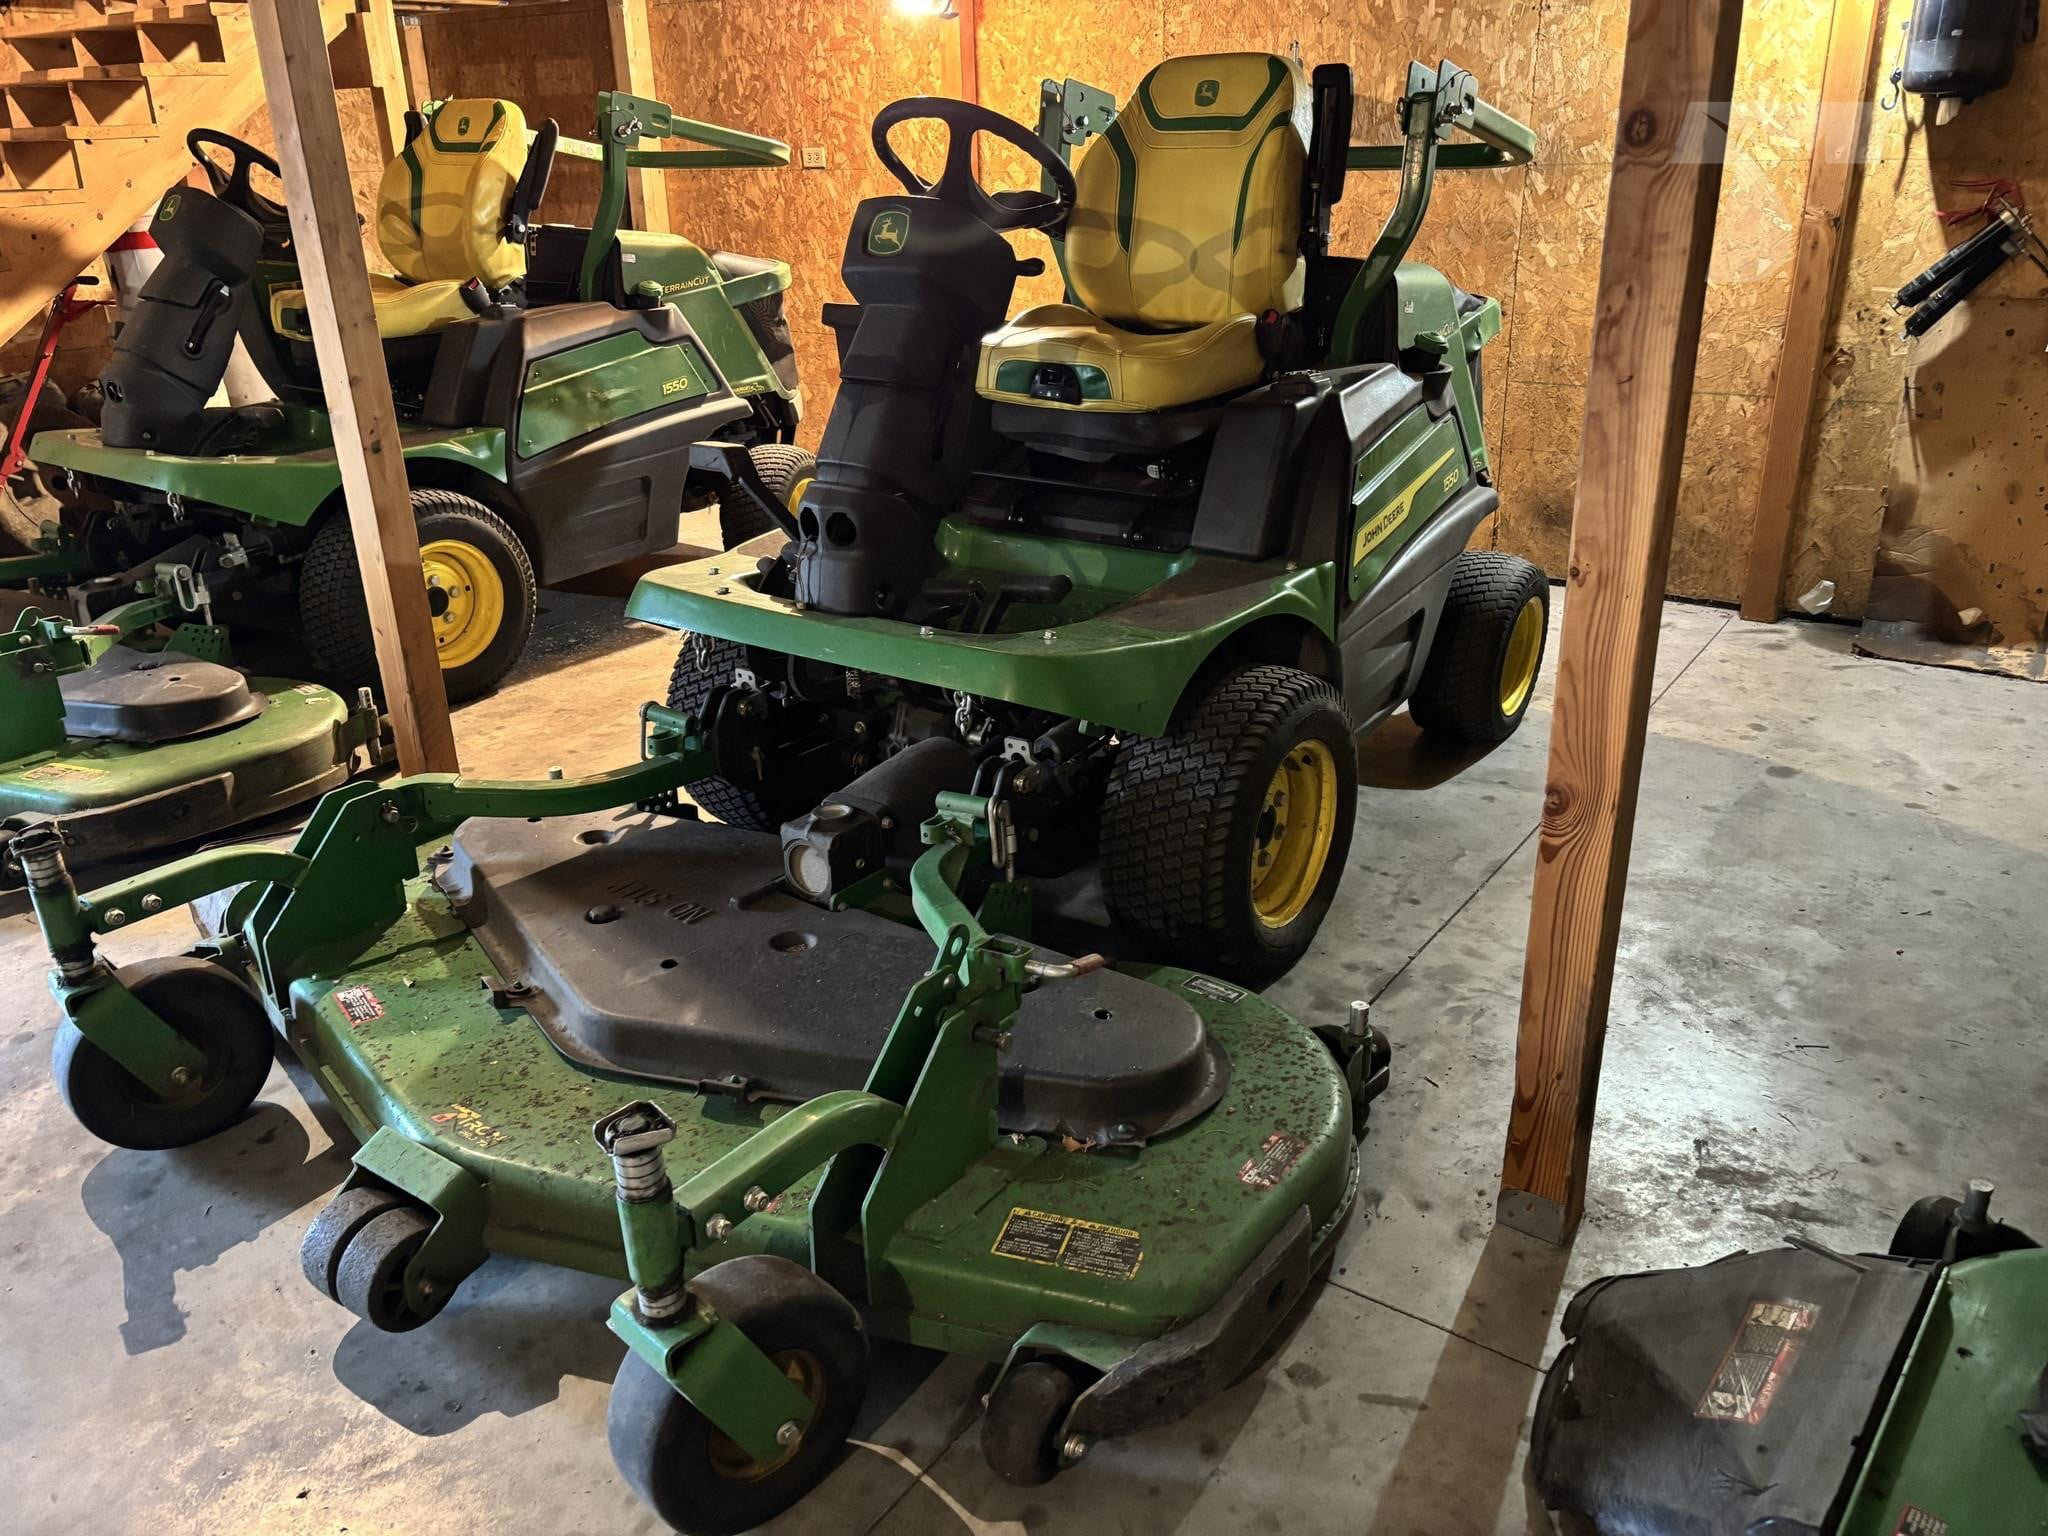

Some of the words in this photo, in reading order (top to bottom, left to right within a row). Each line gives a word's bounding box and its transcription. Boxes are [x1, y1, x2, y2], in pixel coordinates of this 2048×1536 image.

[662, 378, 688, 395] 1550
[1362, 521, 1383, 548] JOHN
[1383, 501, 1405, 530] DEERE
[1032, 1211, 1064, 1222] CAUTION
